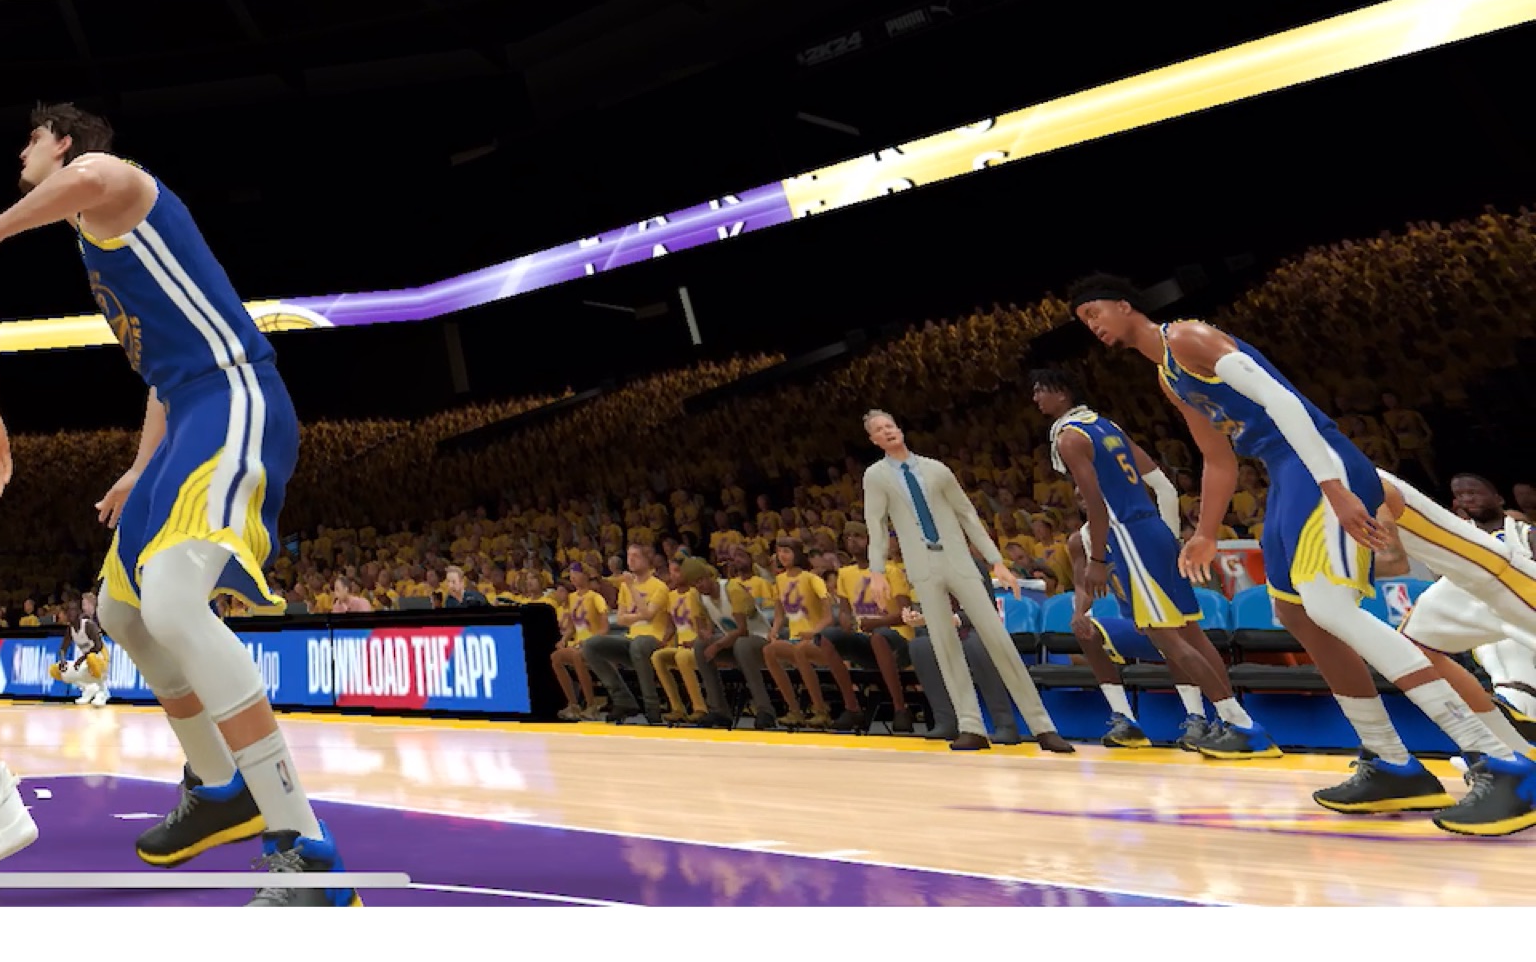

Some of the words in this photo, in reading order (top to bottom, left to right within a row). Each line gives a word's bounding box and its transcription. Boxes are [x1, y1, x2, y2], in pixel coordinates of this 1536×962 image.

[1116, 453, 1139, 485] 5
[307, 637, 411, 697] DOWNLOAD
[411, 635, 453, 698] THE
[453, 635, 498, 698] APP
